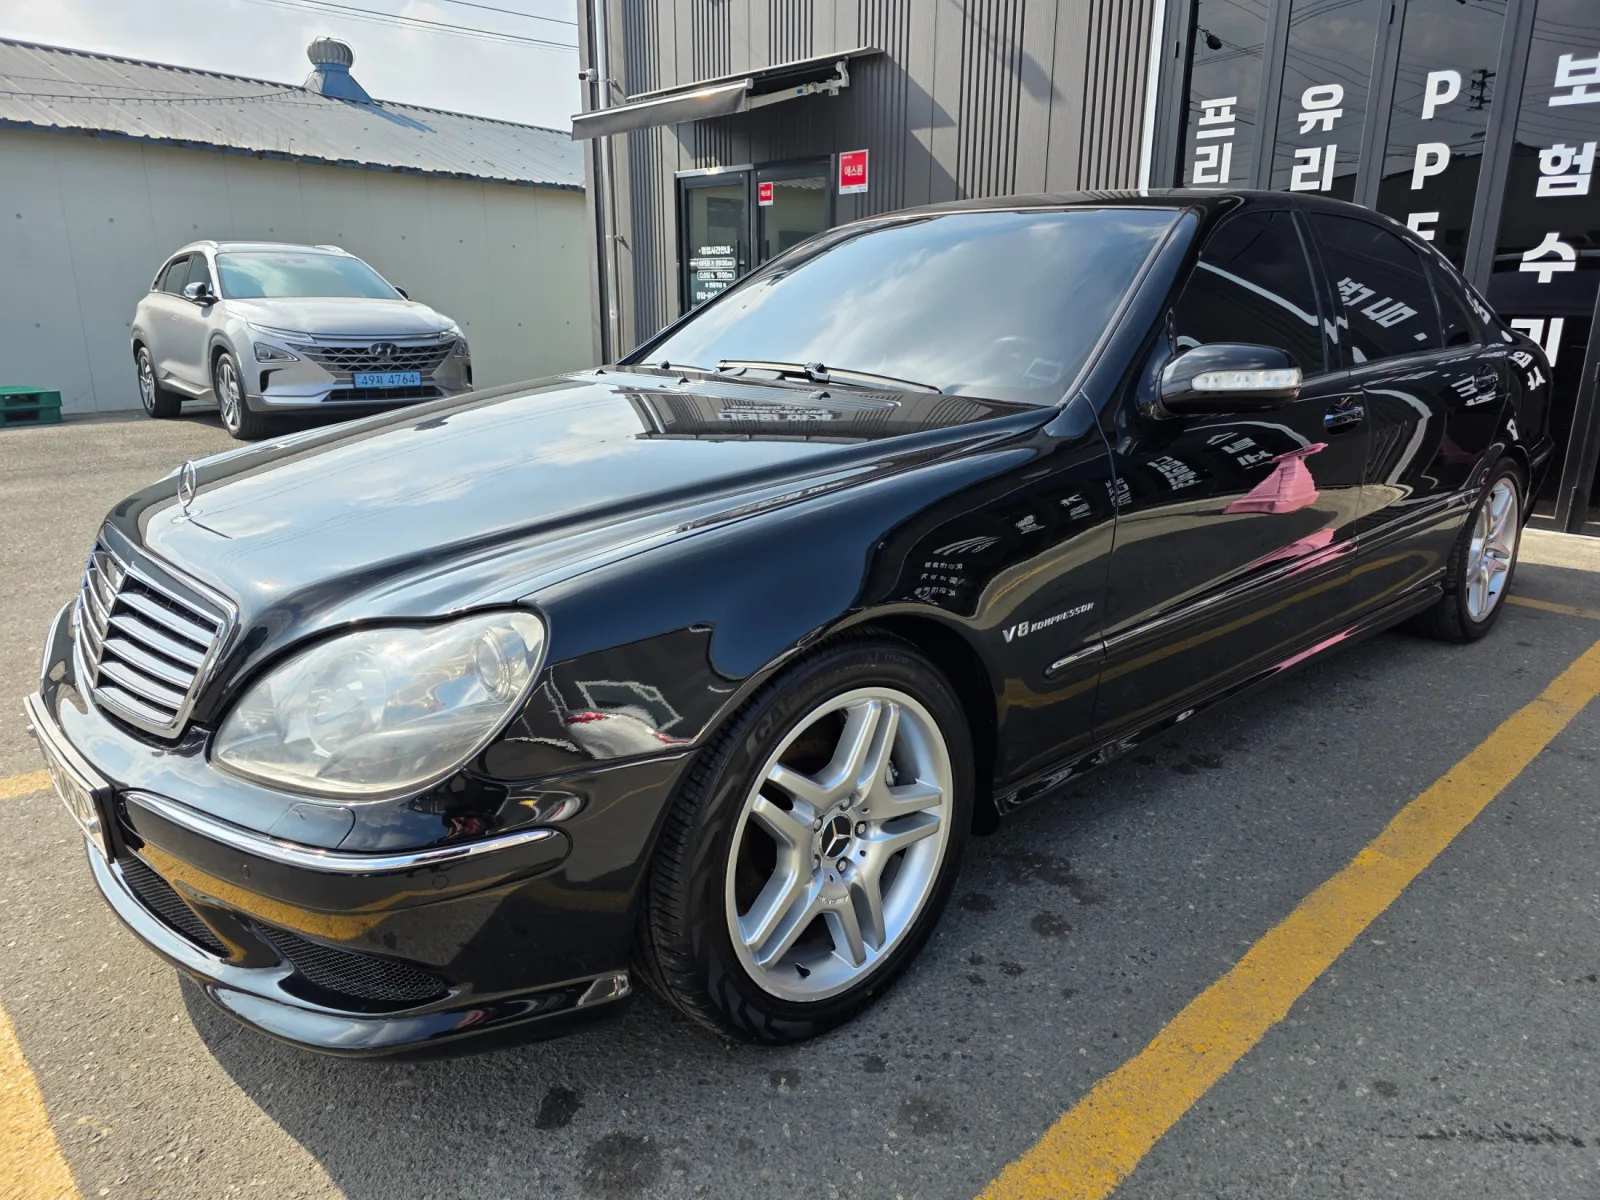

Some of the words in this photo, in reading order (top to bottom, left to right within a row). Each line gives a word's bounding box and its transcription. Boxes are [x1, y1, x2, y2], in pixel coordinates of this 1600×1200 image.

[1193, 96, 1237, 184] 프리
[1290, 84, 1344, 191] 유리
[844, 165, 863, 176] 에스원
[361, 375, 383, 386] 49저
[388, 374, 415, 385] 4764
[1002, 621, 1029, 643] V8
[1030, 602, 1094, 632] KOMPRESSOR
